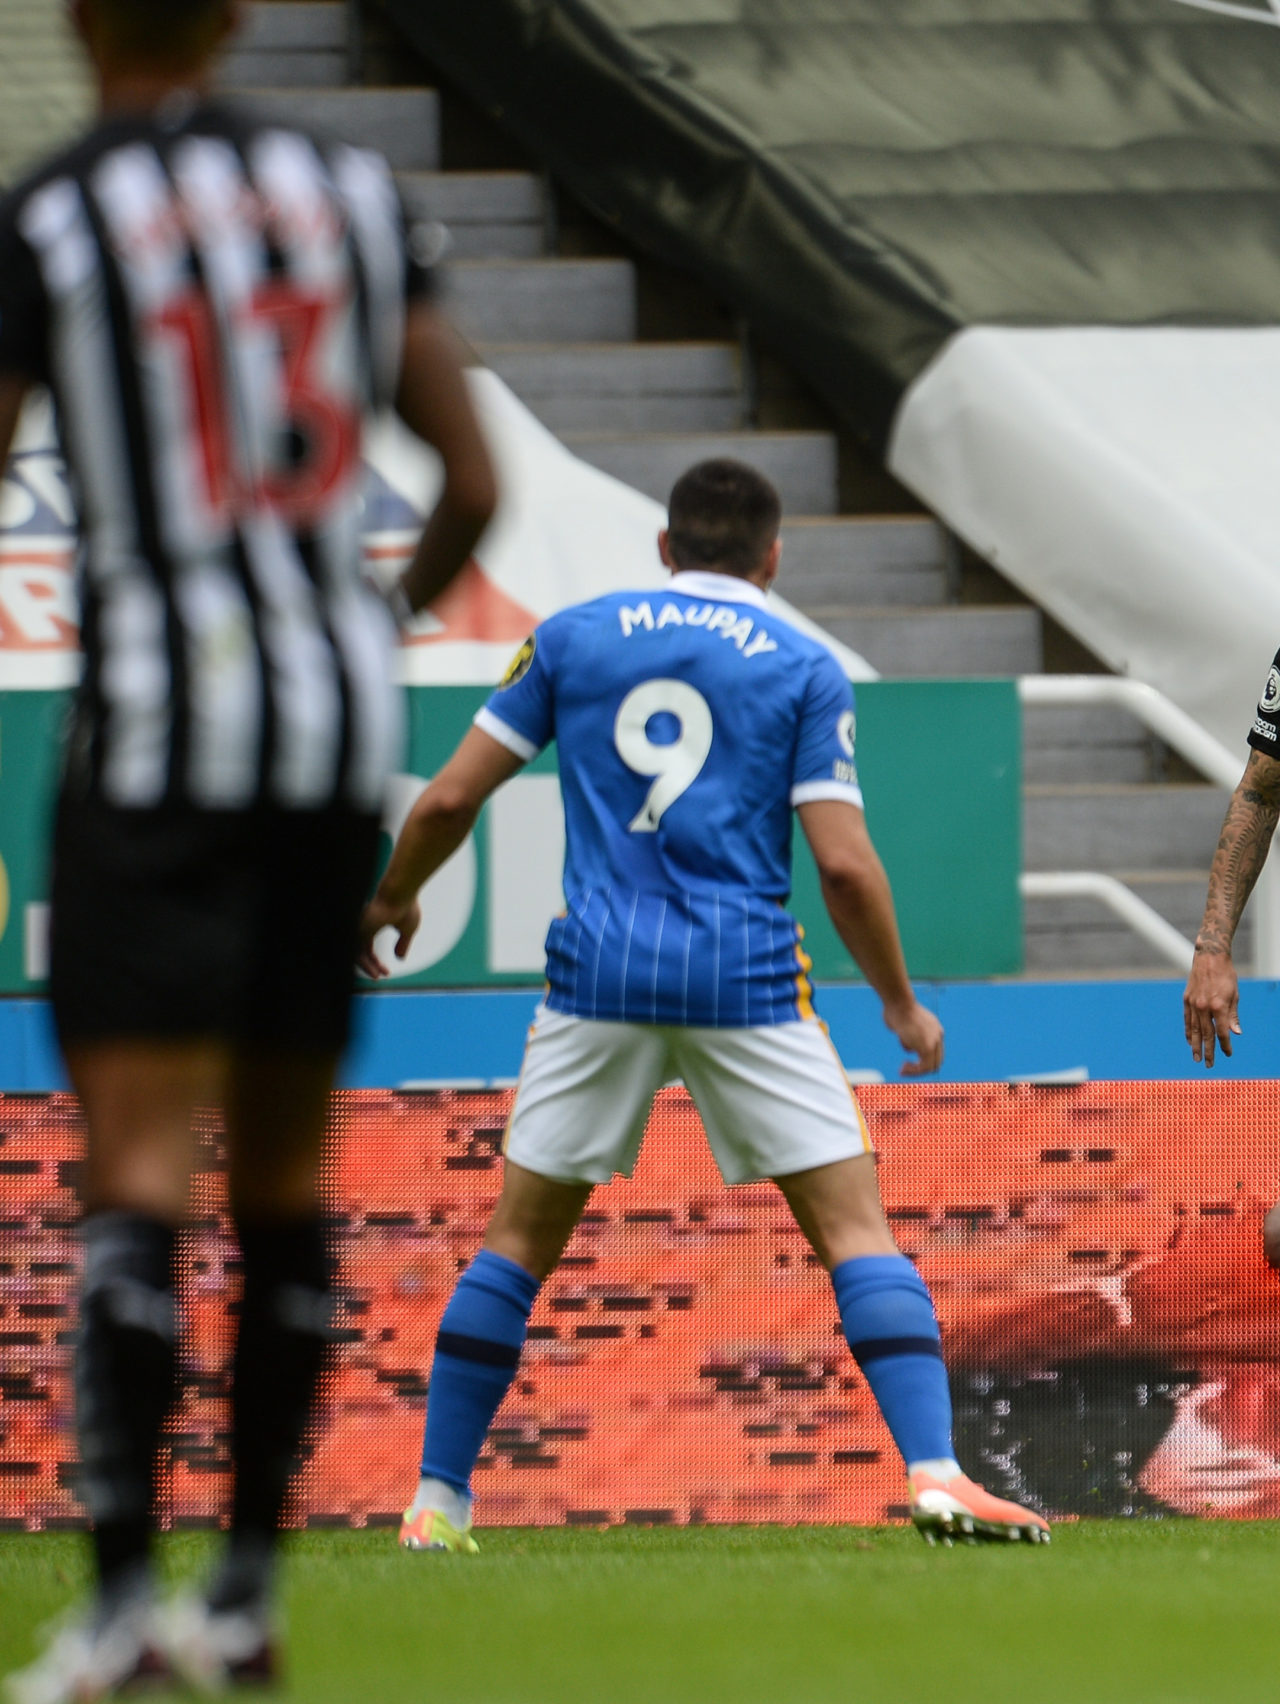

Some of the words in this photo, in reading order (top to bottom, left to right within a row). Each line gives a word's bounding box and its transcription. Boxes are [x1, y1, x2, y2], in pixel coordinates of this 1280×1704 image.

[143, 284, 364, 524] 13
[618, 601, 778, 658] MAUPAY
[613, 678, 714, 833] 9
